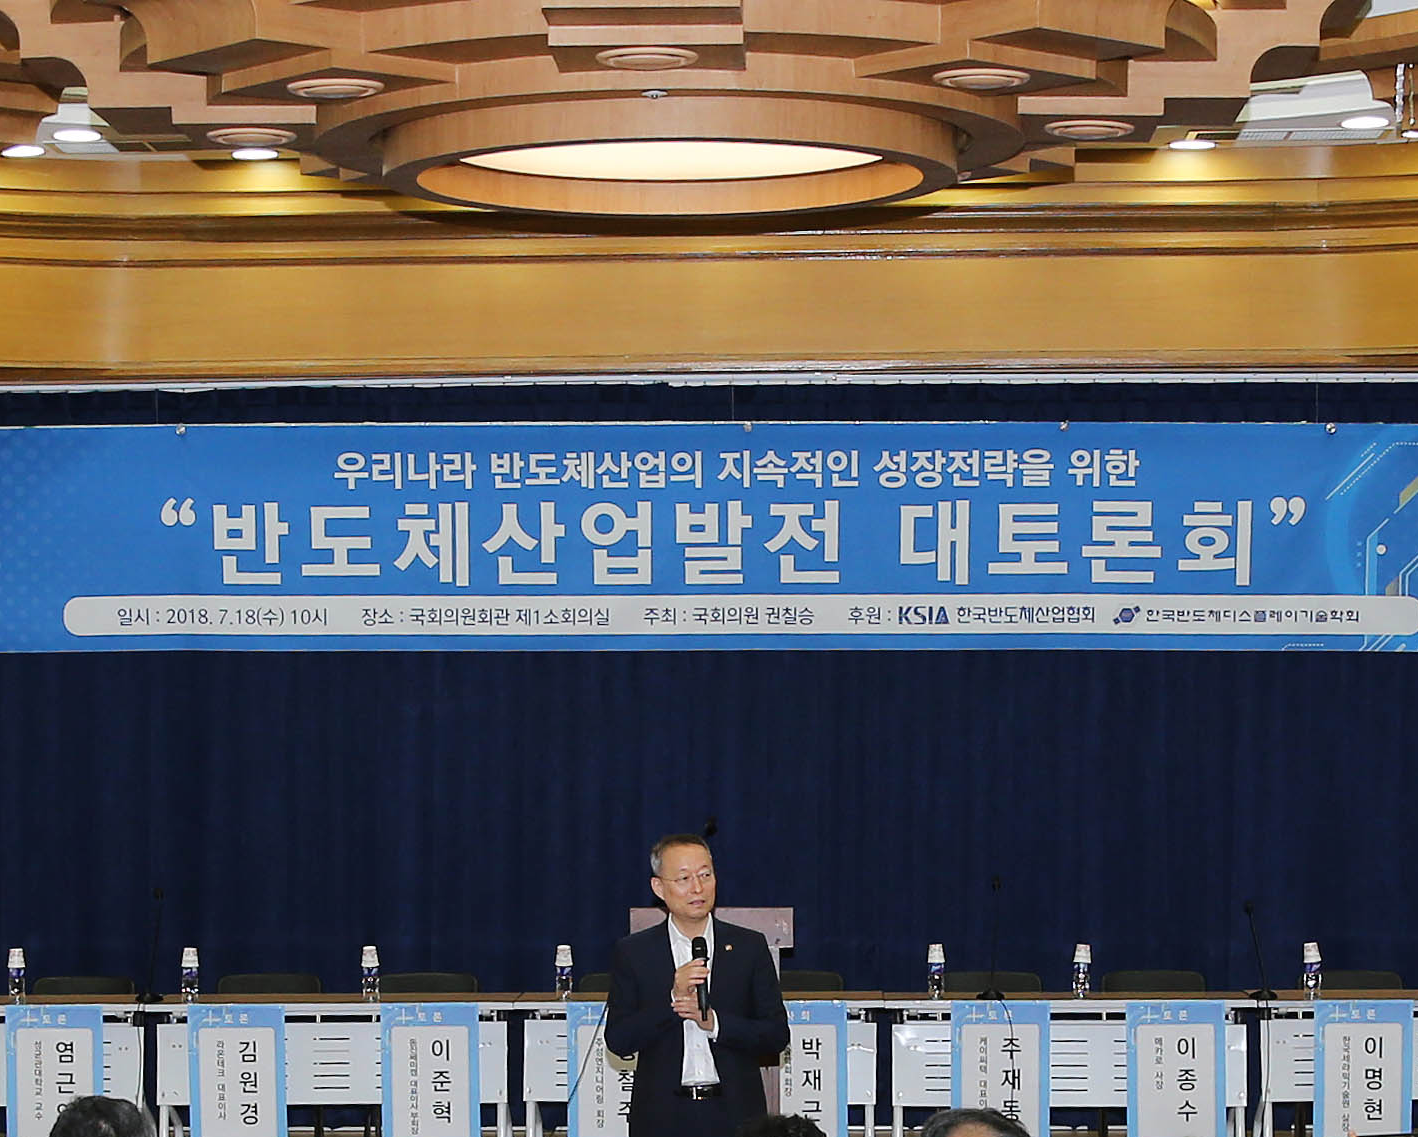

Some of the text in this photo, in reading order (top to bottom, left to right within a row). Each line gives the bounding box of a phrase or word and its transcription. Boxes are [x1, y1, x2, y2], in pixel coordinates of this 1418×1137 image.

[333, 448, 1140, 490] 우리나라 반도체산업의 지속적인 성장전략을 위한
[117, 607, 150, 626] 일시
[291, 608, 327, 626] 10시
[361, 608, 395, 627] 장소
[409, 607, 511, 627] 국회의원회관
[515, 607, 610, 627] 제1소회의실
[643, 607, 677, 626] 주최
[692, 606, 759, 625] 국회의원
[765, 606, 815, 626] 권칠승
[847, 606, 881, 625] 후원
[898, 606, 950, 625] KSIA
[956, 605, 1095, 624] 한국반도체산업협회
[239, 1041, 259, 1126] 김원경
[431, 1039, 453, 1125] 이준혁
[617, 1055, 635, 1123] 철주
[979, 1079, 988, 1109] 대표이
[1001, 1037, 1022, 1122] 주재동
[1154, 1071, 1164, 1090] 사장
[1176, 1036, 1198, 1123] 이종수
[1364, 1036, 1383, 1121] 이명현
[217, 1083, 227, 1121] 대표이사
